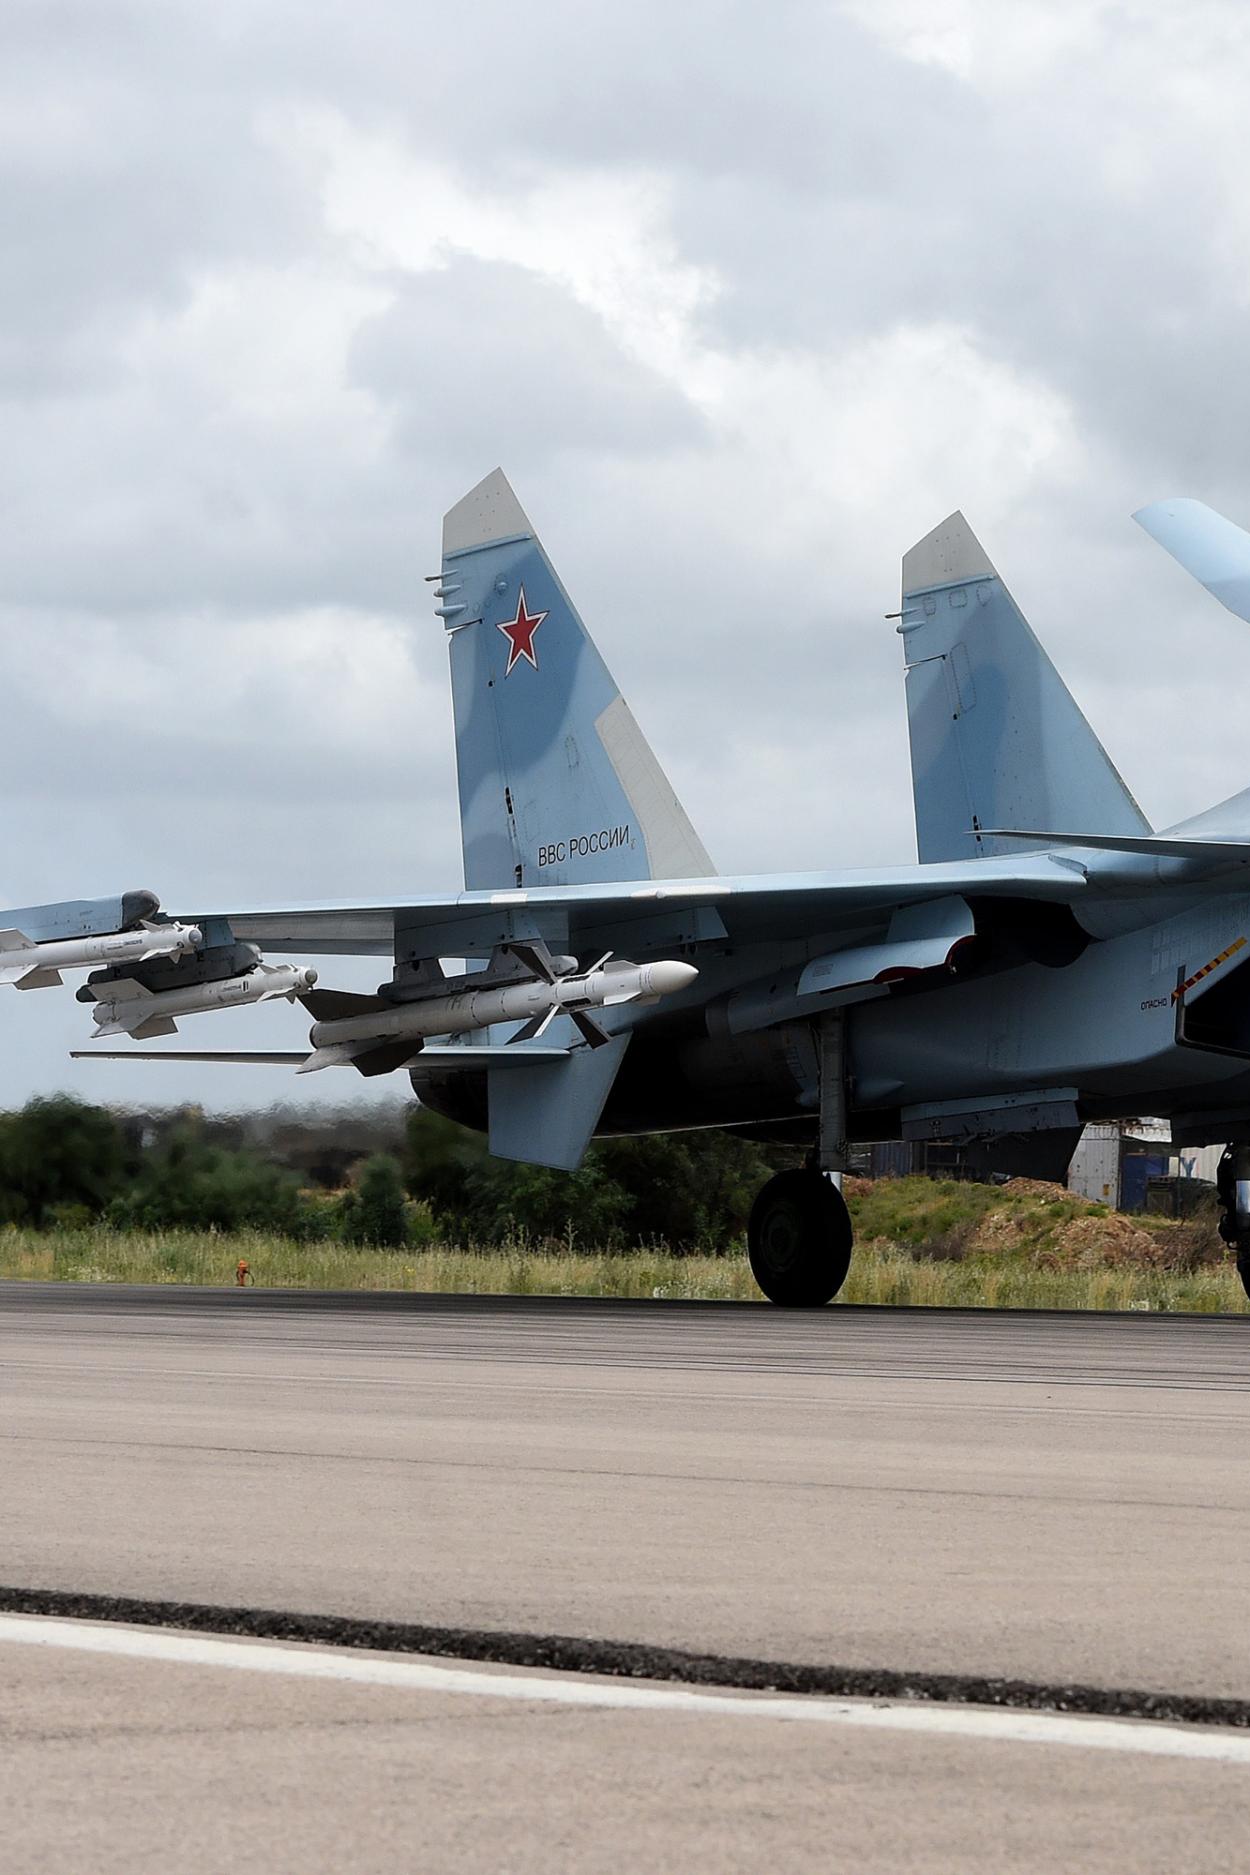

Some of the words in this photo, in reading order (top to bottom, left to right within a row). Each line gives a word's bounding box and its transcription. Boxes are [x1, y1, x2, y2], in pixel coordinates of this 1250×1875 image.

[538, 842, 566, 867] ВВС
[569, 824, 630, 860] РОССИИ
[1140, 997, 1168, 1011] ОПАСНО
